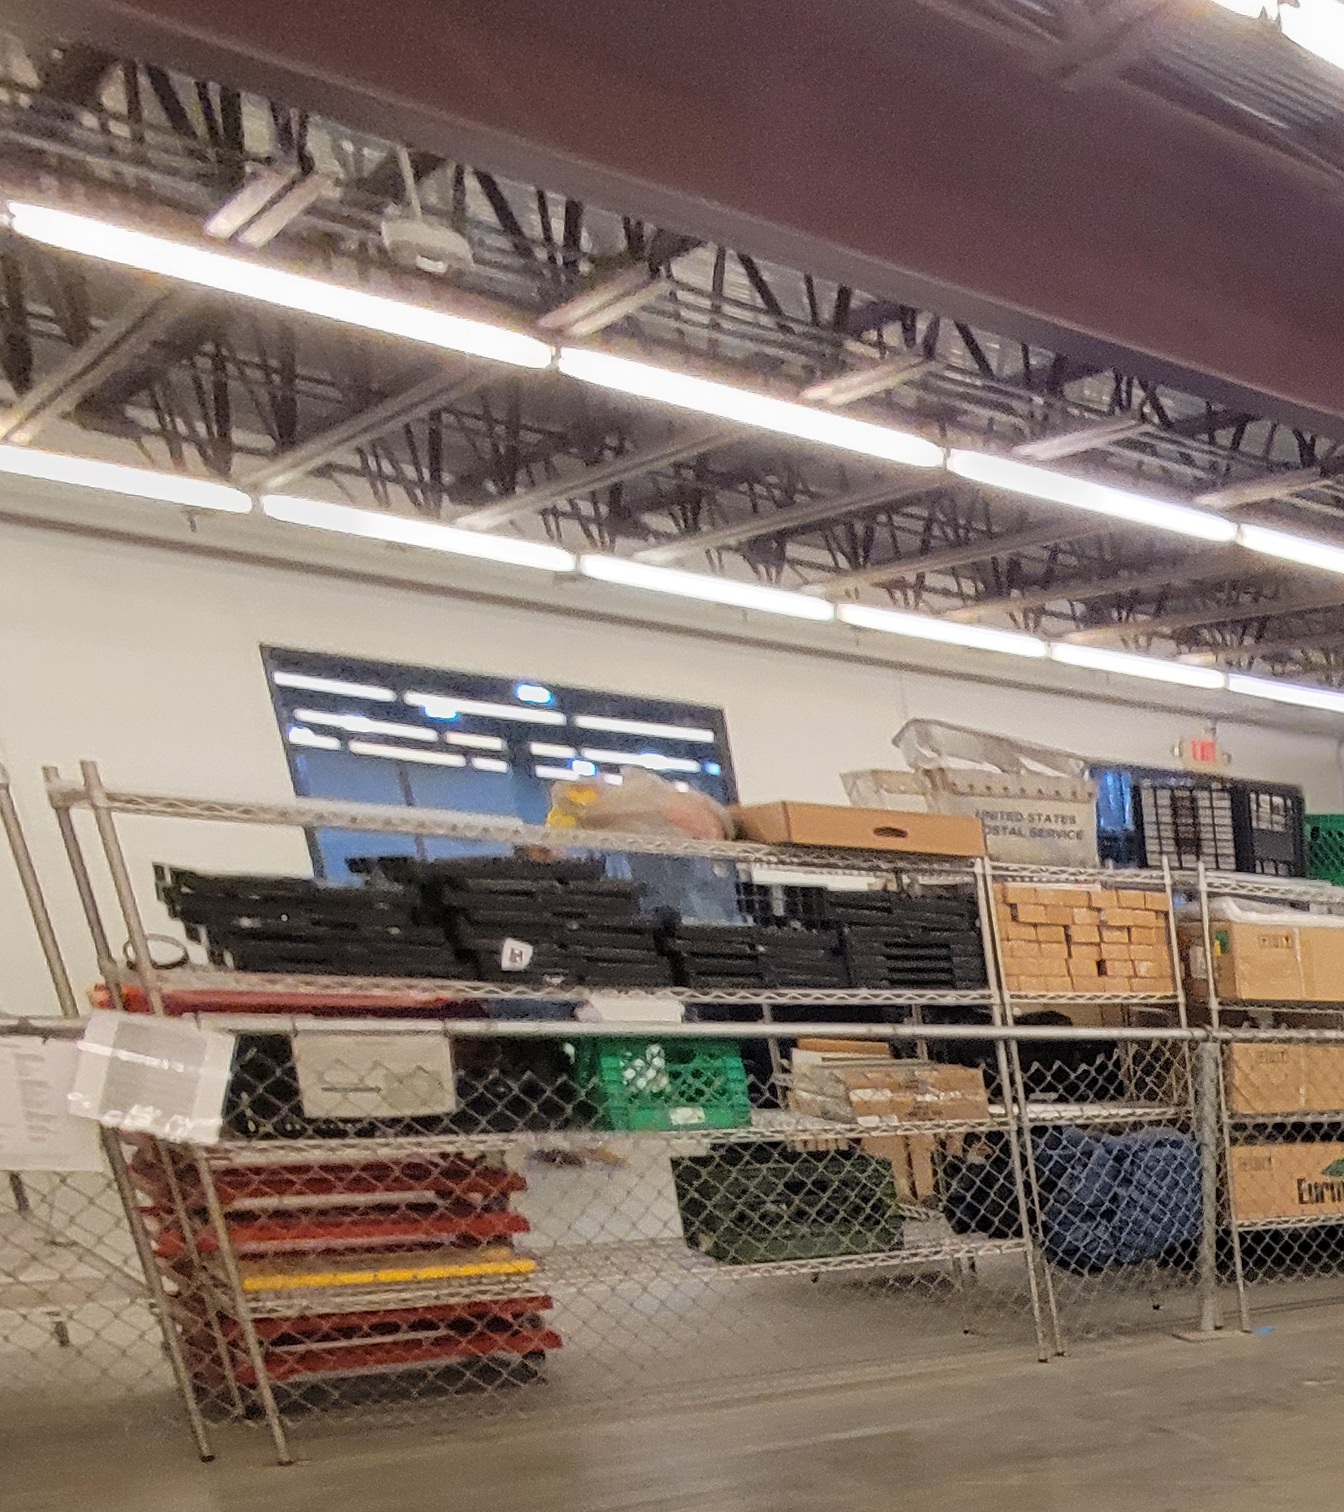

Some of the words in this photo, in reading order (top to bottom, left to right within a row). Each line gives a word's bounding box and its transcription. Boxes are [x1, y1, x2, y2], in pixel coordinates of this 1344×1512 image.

[1027, 812, 1076, 825] STATES
[982, 824, 1025, 838] OSTAL
[1029, 827, 1084, 840] SERVICE
